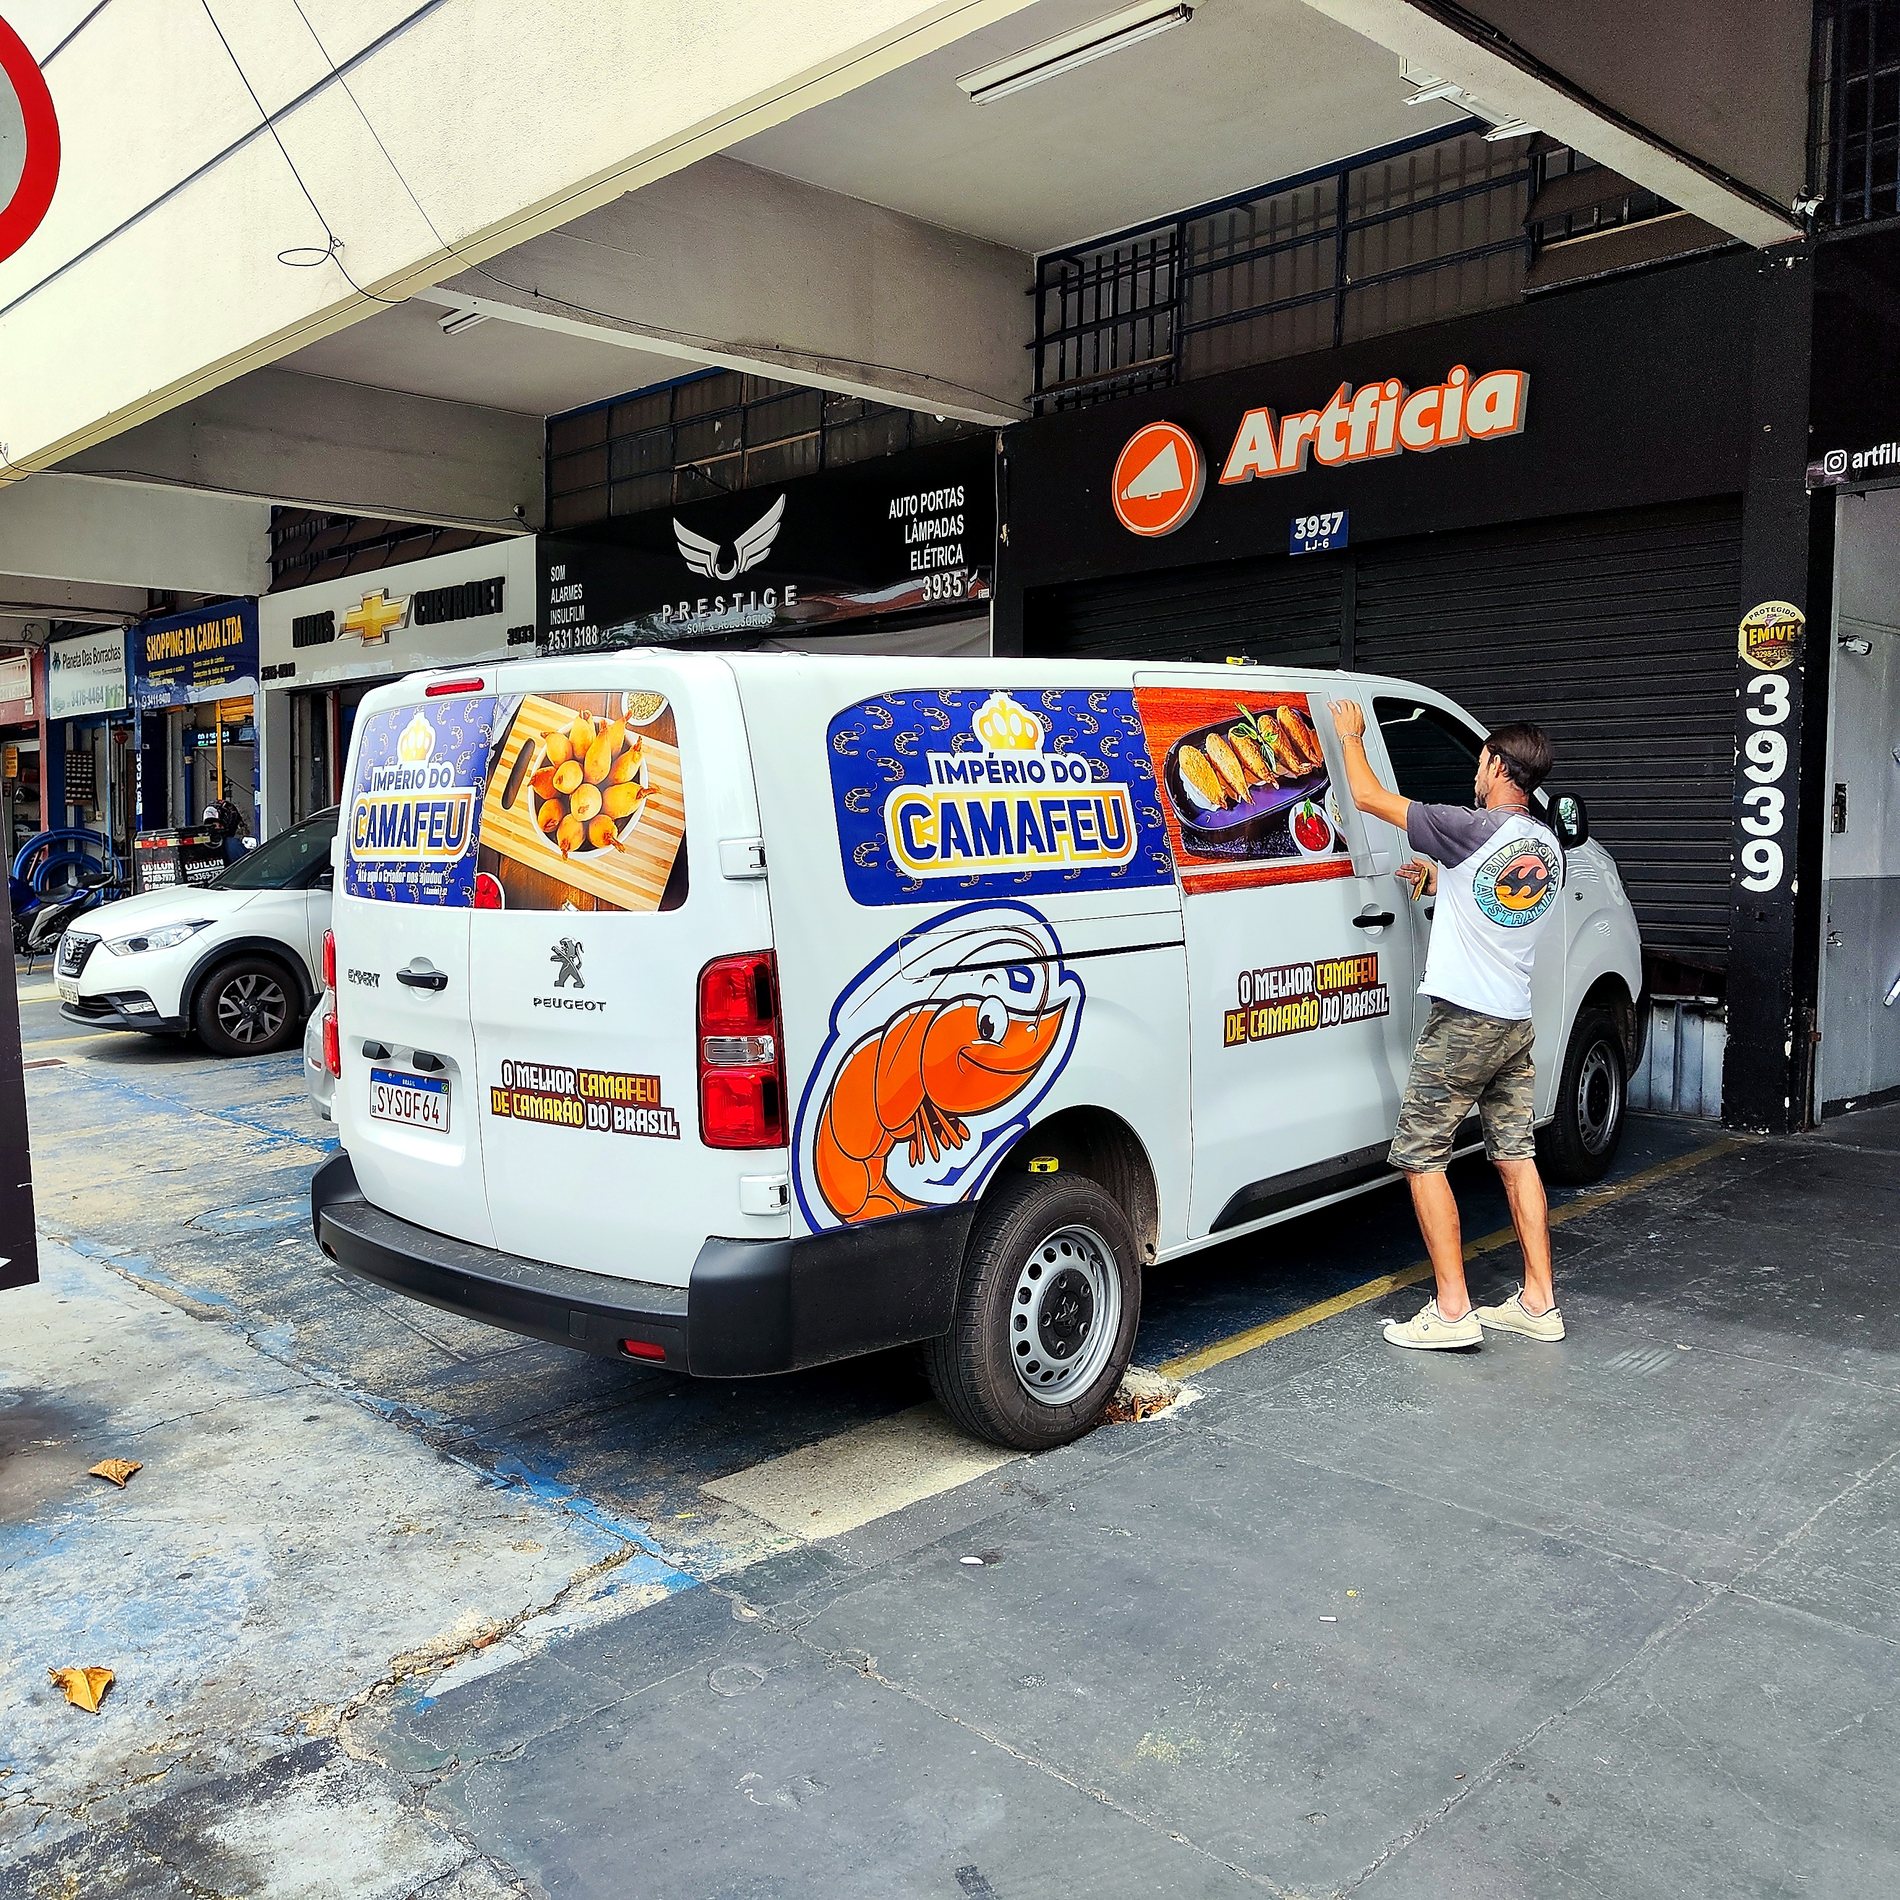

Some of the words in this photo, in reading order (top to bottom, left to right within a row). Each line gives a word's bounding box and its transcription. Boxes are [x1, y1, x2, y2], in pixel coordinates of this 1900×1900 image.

[1219, 364, 1529, 485] Artficia
[1852, 442, 1900, 469] artfil
[889, 494, 918, 519] AUTO
[920, 485, 965, 514] PORTAS
[905, 514, 965, 544] LÂMPADAS
[1294, 511, 1344, 539] 3937
[910, 543, 964, 571] ELÉTRICA
[1304, 538, 1330, 551] LJ-6
[550, 564, 566, 583] SOM
[922, 571, 963, 601] 3935
[414, 576, 506, 626] CHEVROLET
[550, 583, 583, 604] ALARMES
[662, 584, 797, 623] PRESTIGE
[550, 605, 585, 626] INSULFILM
[687, 622, 705, 635] SOM
[1748, 606, 1797, 621] PROTEGIDO
[146, 628, 184, 662] SHOPPING
[185, 626, 196, 655] DA
[196, 620, 221, 652] CAIXA
[222, 614, 243, 646] LTDA
[548, 628, 573, 650] 2531
[574, 625, 598, 648] 3188
[1749, 625, 1796, 647] EMIVE
[373, 764, 425, 789] IMPÉRIO
[428, 767, 451, 789] DO
[934, 752, 1046, 784] IMPÉRIO
[1046, 759, 1087, 784] DO
[1740, 674, 1791, 893] 3939
[354, 801, 467, 848] CAMAFEU
[899, 797, 1127, 861] CAMAFEU
[1482, 840, 1560, 878] BILLABONG
[1240, 973, 1252, 1005] O
[1254, 965, 1313, 1001] MELHOR
[1316, 955, 1377, 991] CAMAFEU
[533, 996, 607, 1012] PEUGEOT
[1226, 1012, 1246, 1043] DE
[1250, 997, 1319, 1037] CAMARÃO
[1322, 994, 1339, 1025] DO
[1342, 987, 1389, 1020] BRASIL
[502, 1061, 515, 1088] O
[516, 1063, 576, 1096] MELHOR
[579, 1072, 659, 1104] CAMAFEU
[492, 1090, 510, 1114] DE
[512, 1092, 584, 1126] CAMARÃO
[586, 1104, 611, 1130] DO
[612, 1106, 679, 1137] BRASIL
